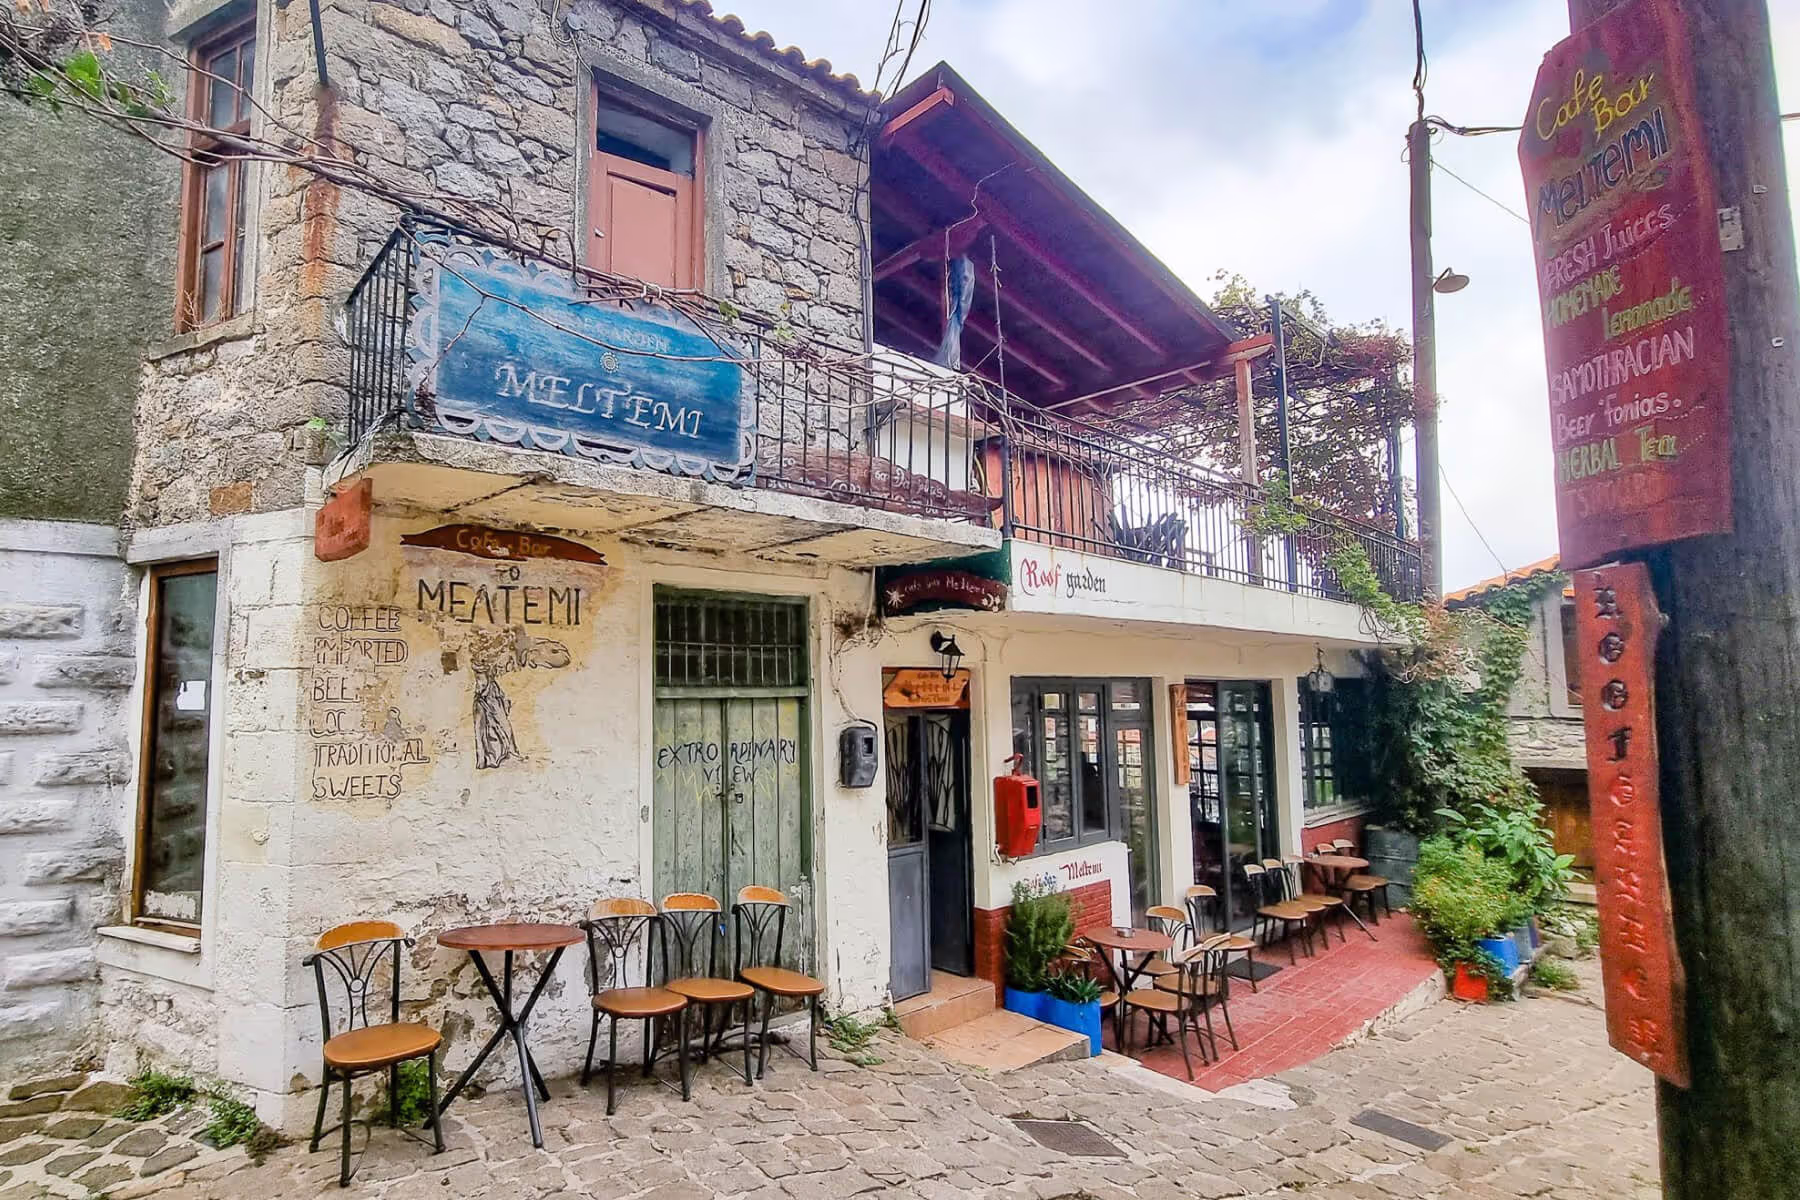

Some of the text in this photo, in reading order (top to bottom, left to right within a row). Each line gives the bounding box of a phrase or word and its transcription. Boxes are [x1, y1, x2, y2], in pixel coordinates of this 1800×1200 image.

[1536, 69, 1602, 141] Cafe
[1593, 72, 1656, 143] Bar
[495, 363, 704, 439] MELTEMI
